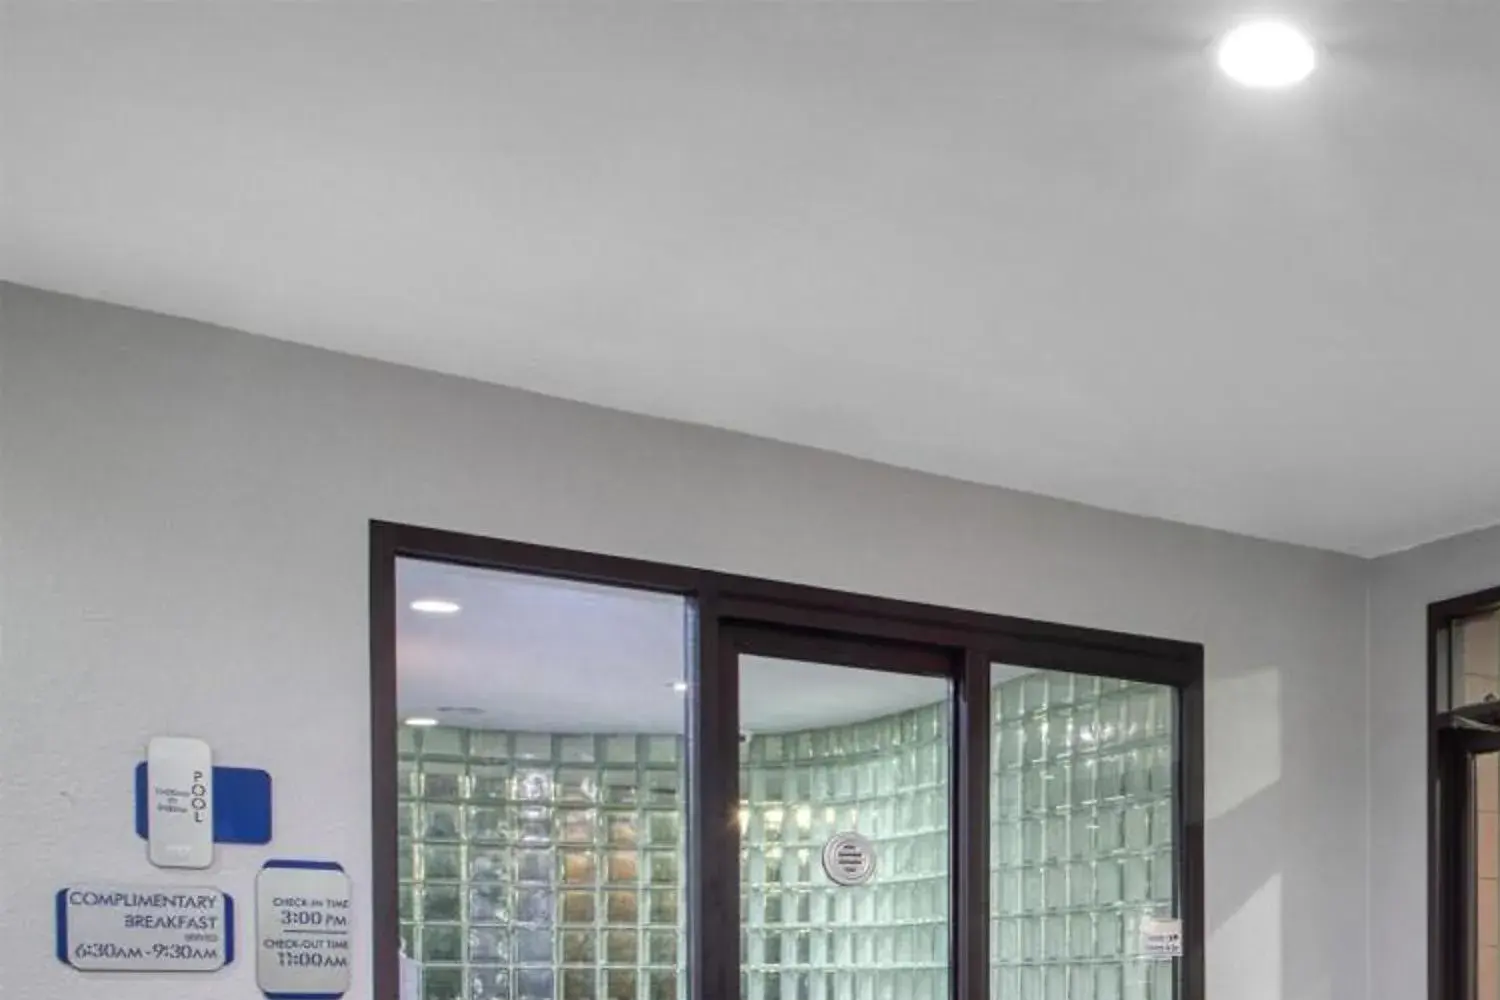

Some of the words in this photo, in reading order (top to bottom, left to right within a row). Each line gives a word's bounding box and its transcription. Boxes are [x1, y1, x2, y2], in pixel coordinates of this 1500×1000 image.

[69, 891, 217, 909] COMPLIMENTARY
[124, 914, 218, 929] BREAKFAST
[281, 911, 322, 925] 3:00
[326, 913, 347, 926] PM
